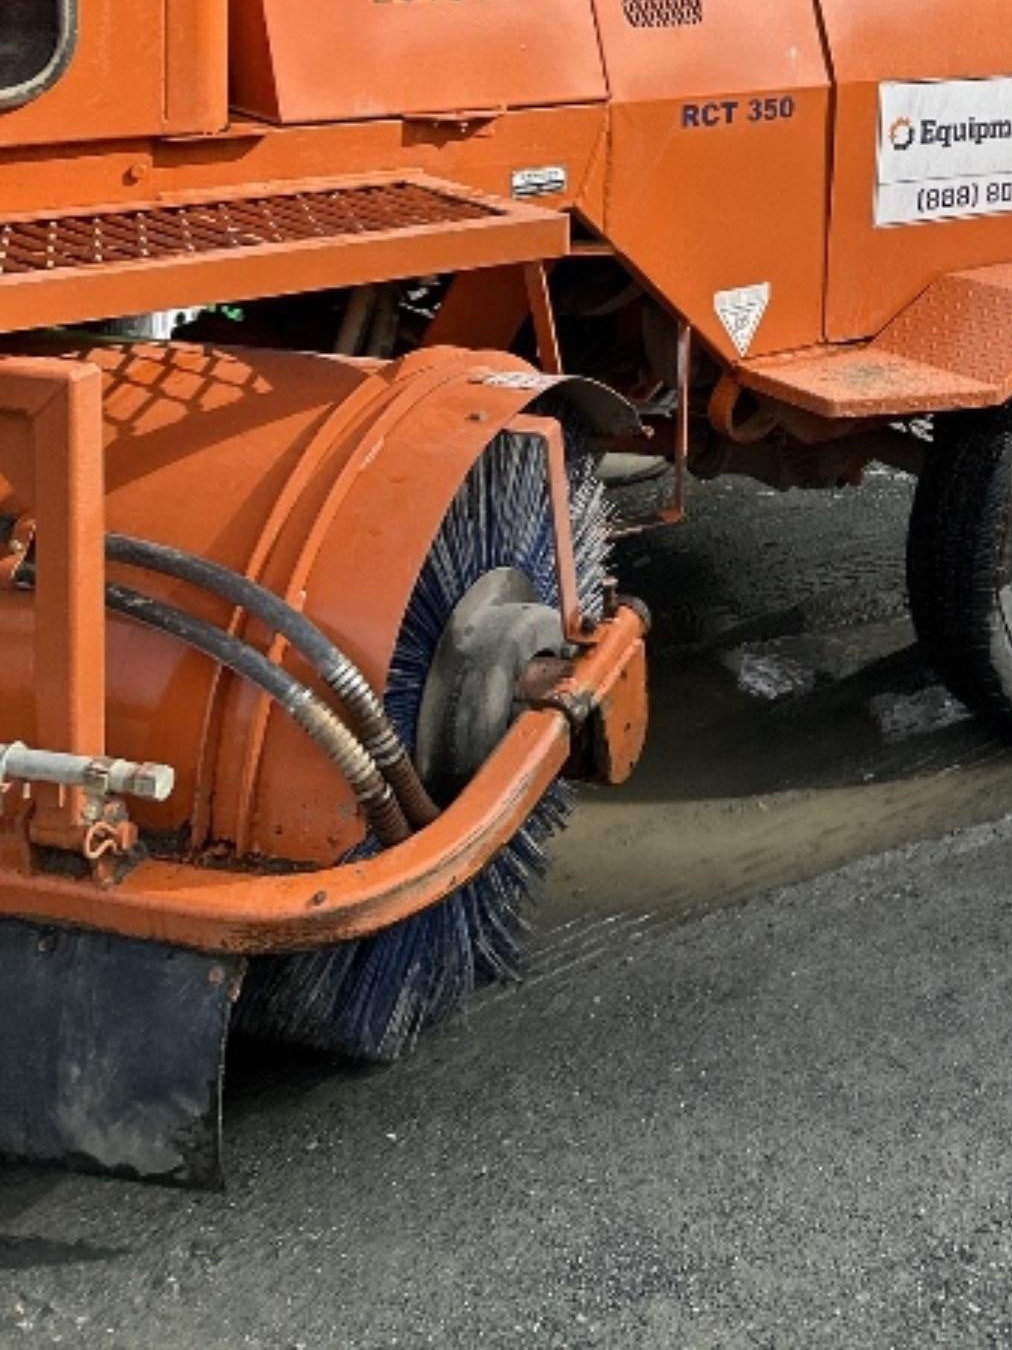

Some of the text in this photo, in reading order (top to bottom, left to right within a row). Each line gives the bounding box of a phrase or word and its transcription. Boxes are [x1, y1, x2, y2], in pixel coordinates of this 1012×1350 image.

[681, 97, 794, 128] RCT 350
[917, 183, 979, 213] (888)
